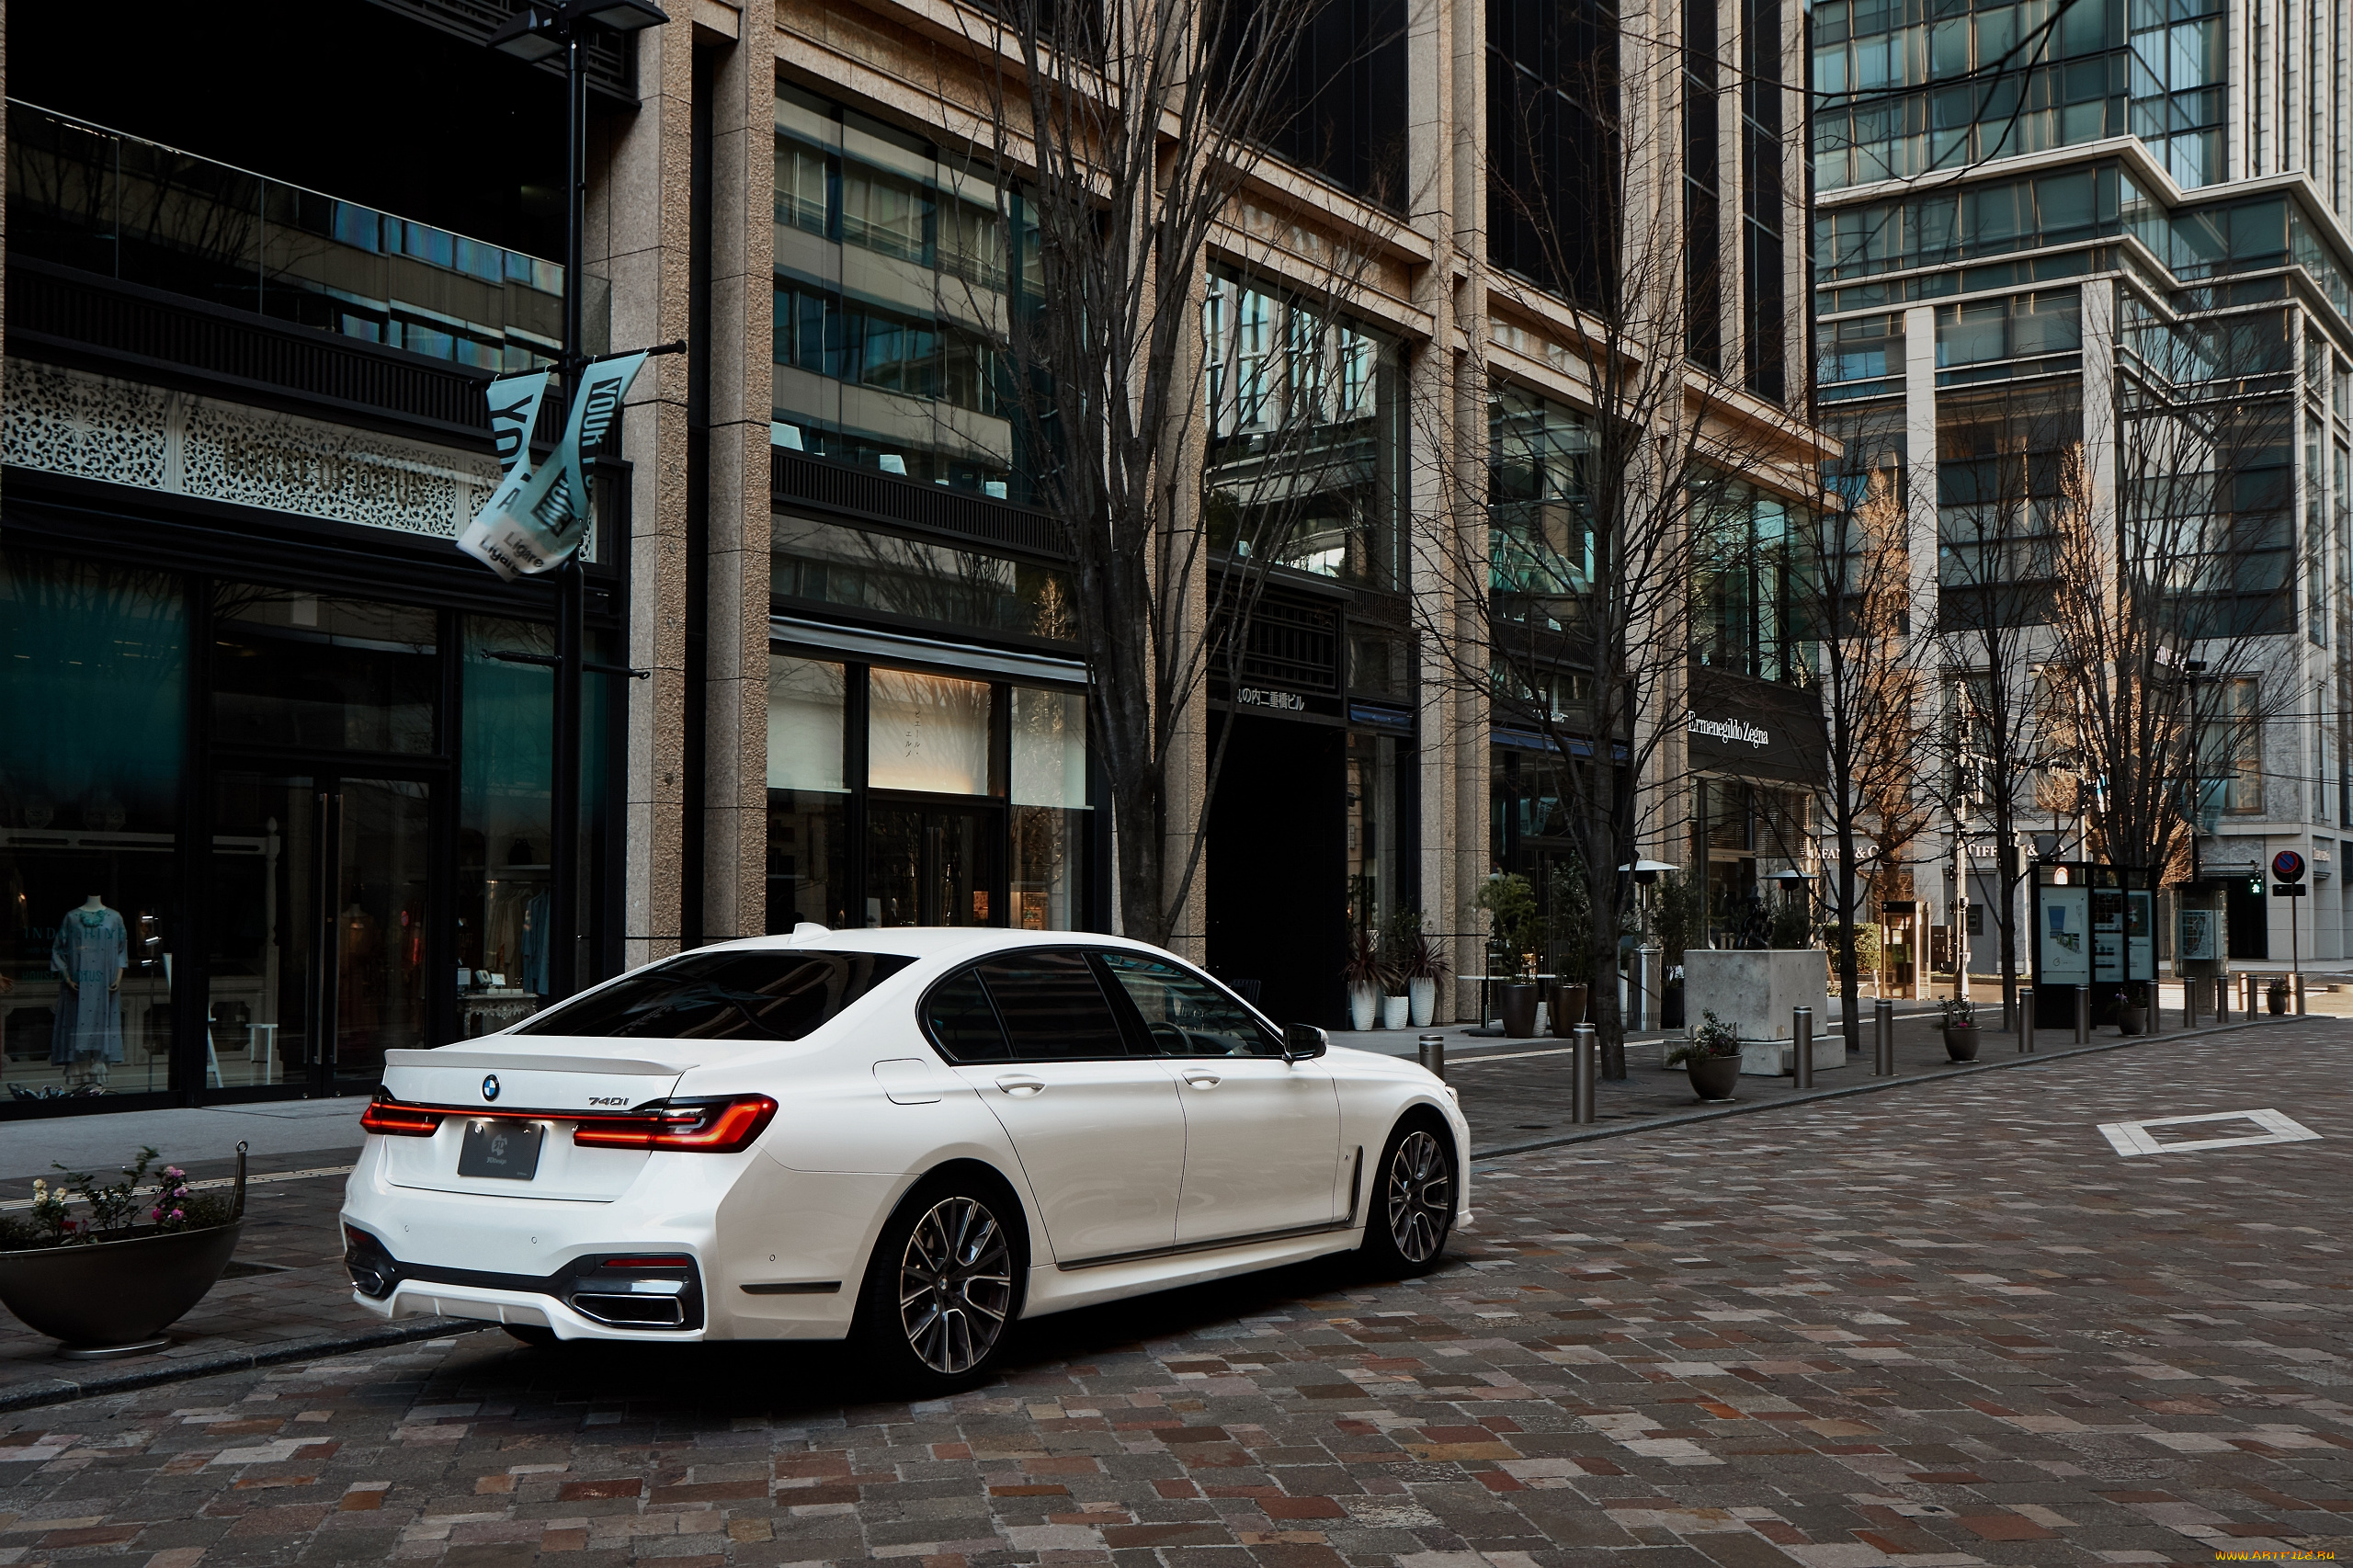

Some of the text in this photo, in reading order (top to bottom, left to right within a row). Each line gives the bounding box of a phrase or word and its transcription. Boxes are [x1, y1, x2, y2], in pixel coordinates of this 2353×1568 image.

[223, 437, 426, 506] HOUSE OF LOTUS
[1687, 710, 1769, 749] Ermenegildo Zegna
